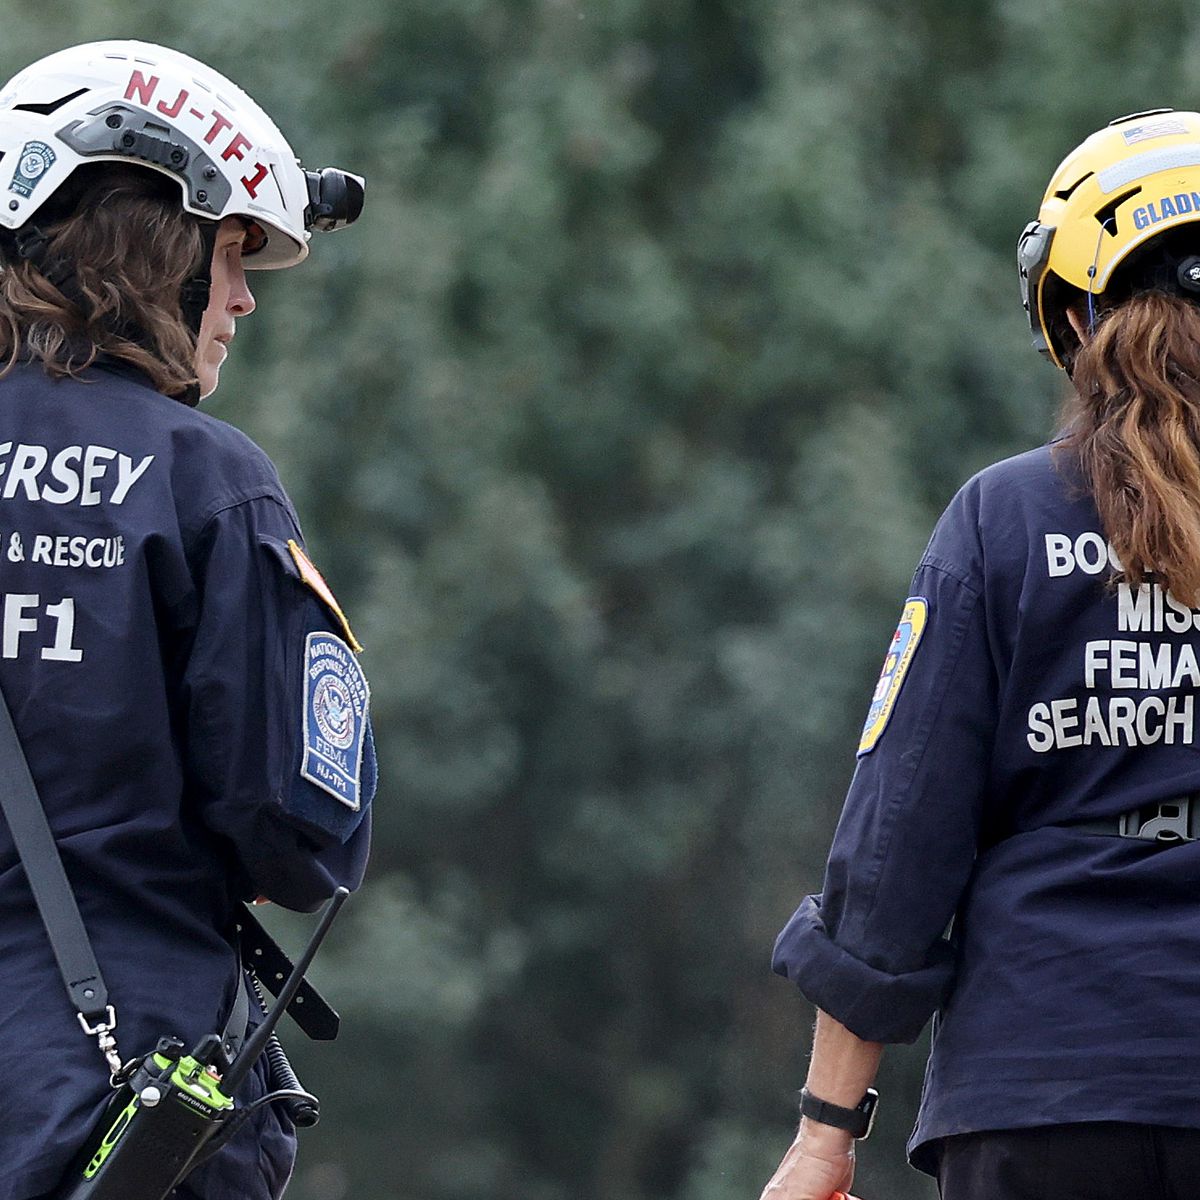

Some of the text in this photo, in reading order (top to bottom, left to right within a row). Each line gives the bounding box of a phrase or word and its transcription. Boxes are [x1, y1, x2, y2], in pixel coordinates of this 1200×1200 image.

[124, 70, 269, 200] NJ-TF1
[7, 531, 25, 562] &
[31, 535, 125, 568] RESCUE
[310, 642, 348, 667] NATIONAL
[1027, 696, 1194, 753] SEARCH
[316, 735, 350, 773] FEMA
[316, 762, 347, 793] NJ-TF1
[177, 1091, 212, 1115] MOTOROLA
